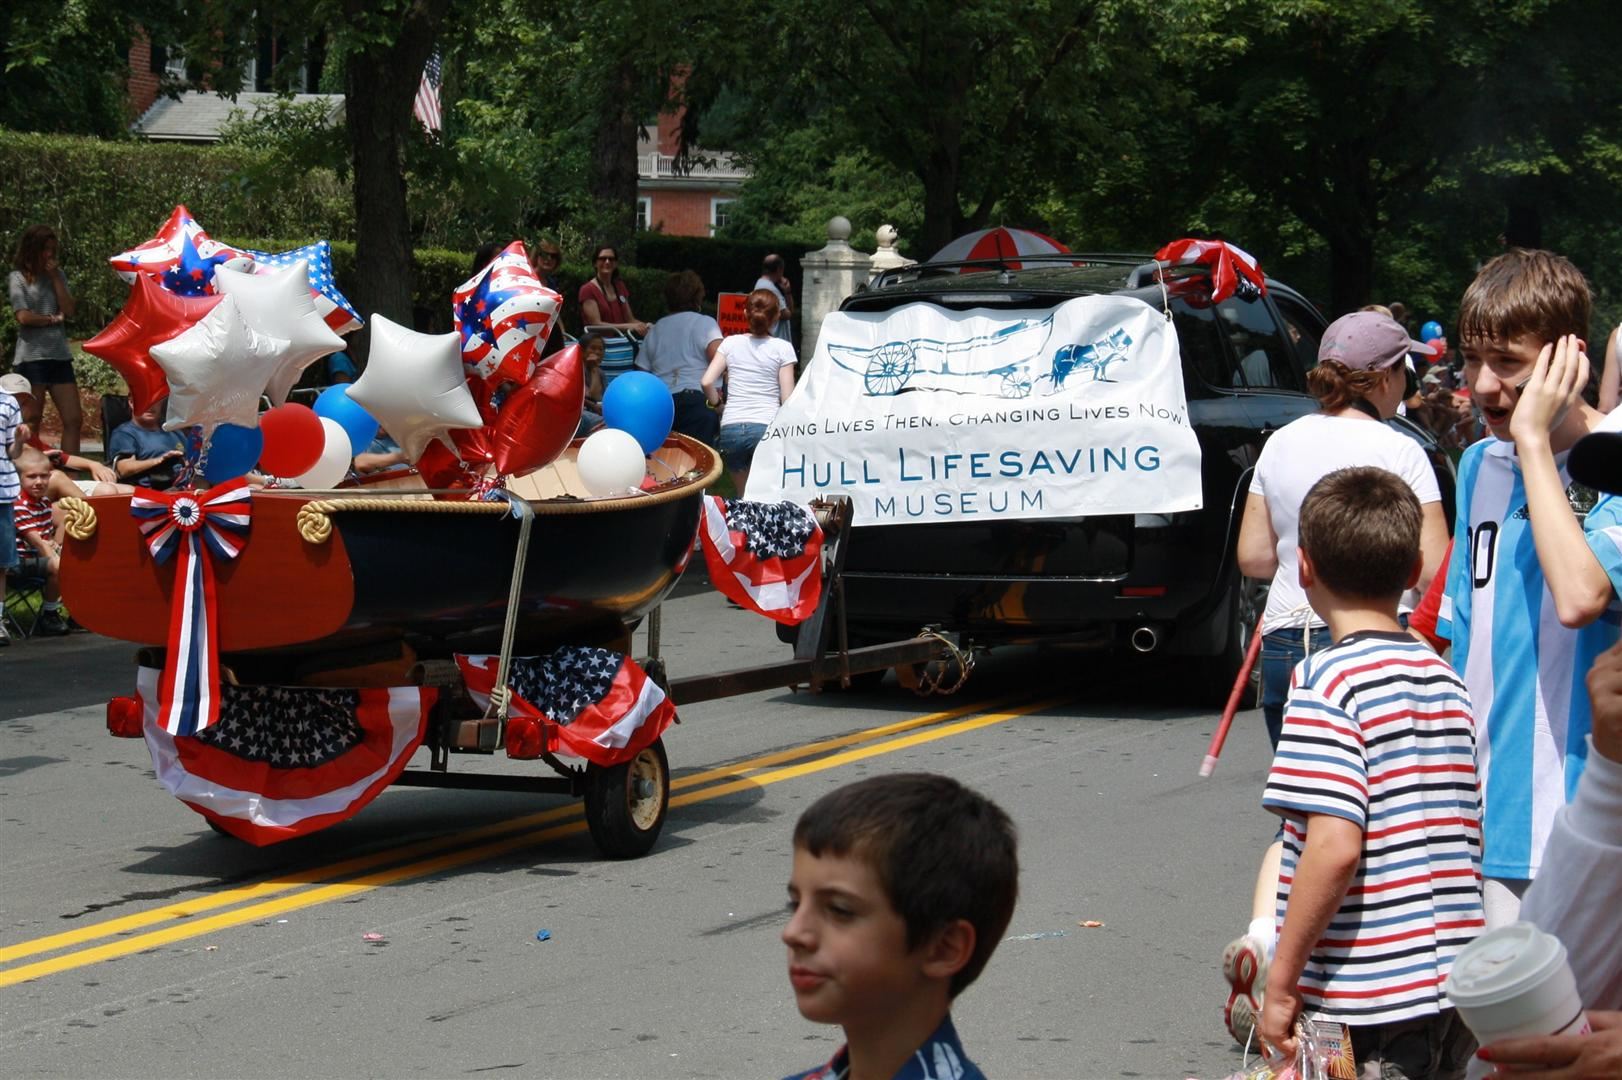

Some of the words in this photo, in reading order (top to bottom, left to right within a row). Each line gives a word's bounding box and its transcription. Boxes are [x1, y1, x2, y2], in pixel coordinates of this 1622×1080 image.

[825, 418, 875, 434] LIVES
[883, 413, 939, 431] THEN.
[948, 408, 1060, 426] CHANGING
[1069, 403, 1130, 420] LIVES
[781, 453, 881, 489] HULL
[898, 445, 1160, 482] LIFESAVING
[875, 489, 1043, 518] MUSEUM
